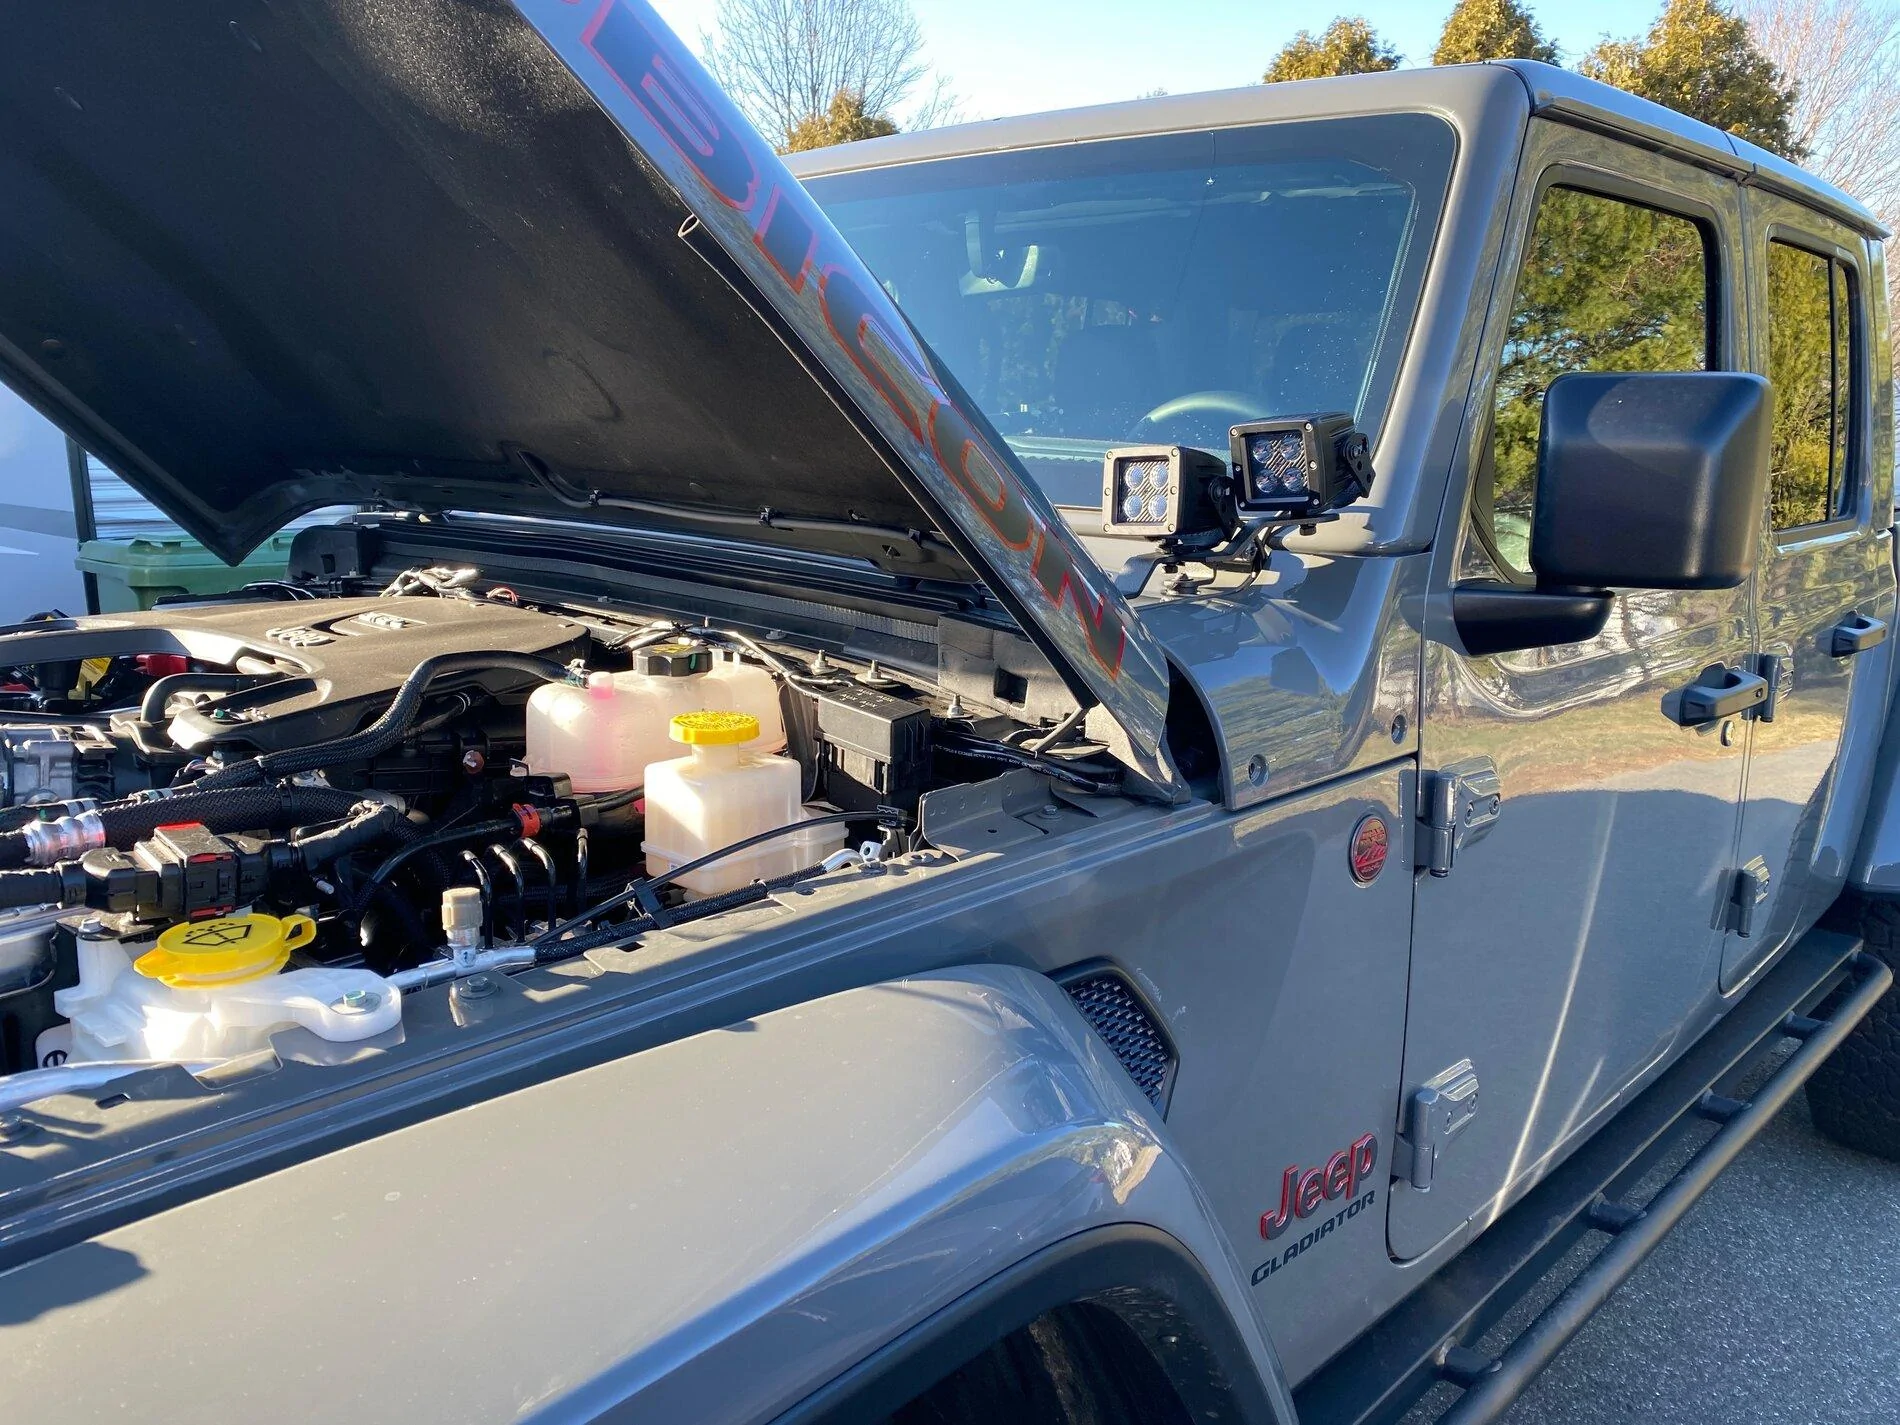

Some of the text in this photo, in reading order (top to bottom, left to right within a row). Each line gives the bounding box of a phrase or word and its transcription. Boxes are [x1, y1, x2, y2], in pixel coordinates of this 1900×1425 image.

[560, 0, 1126, 682] BICON
[1251, 1190, 1375, 1286] GLADIATOR
[1260, 1132, 1378, 1240] Jeep
